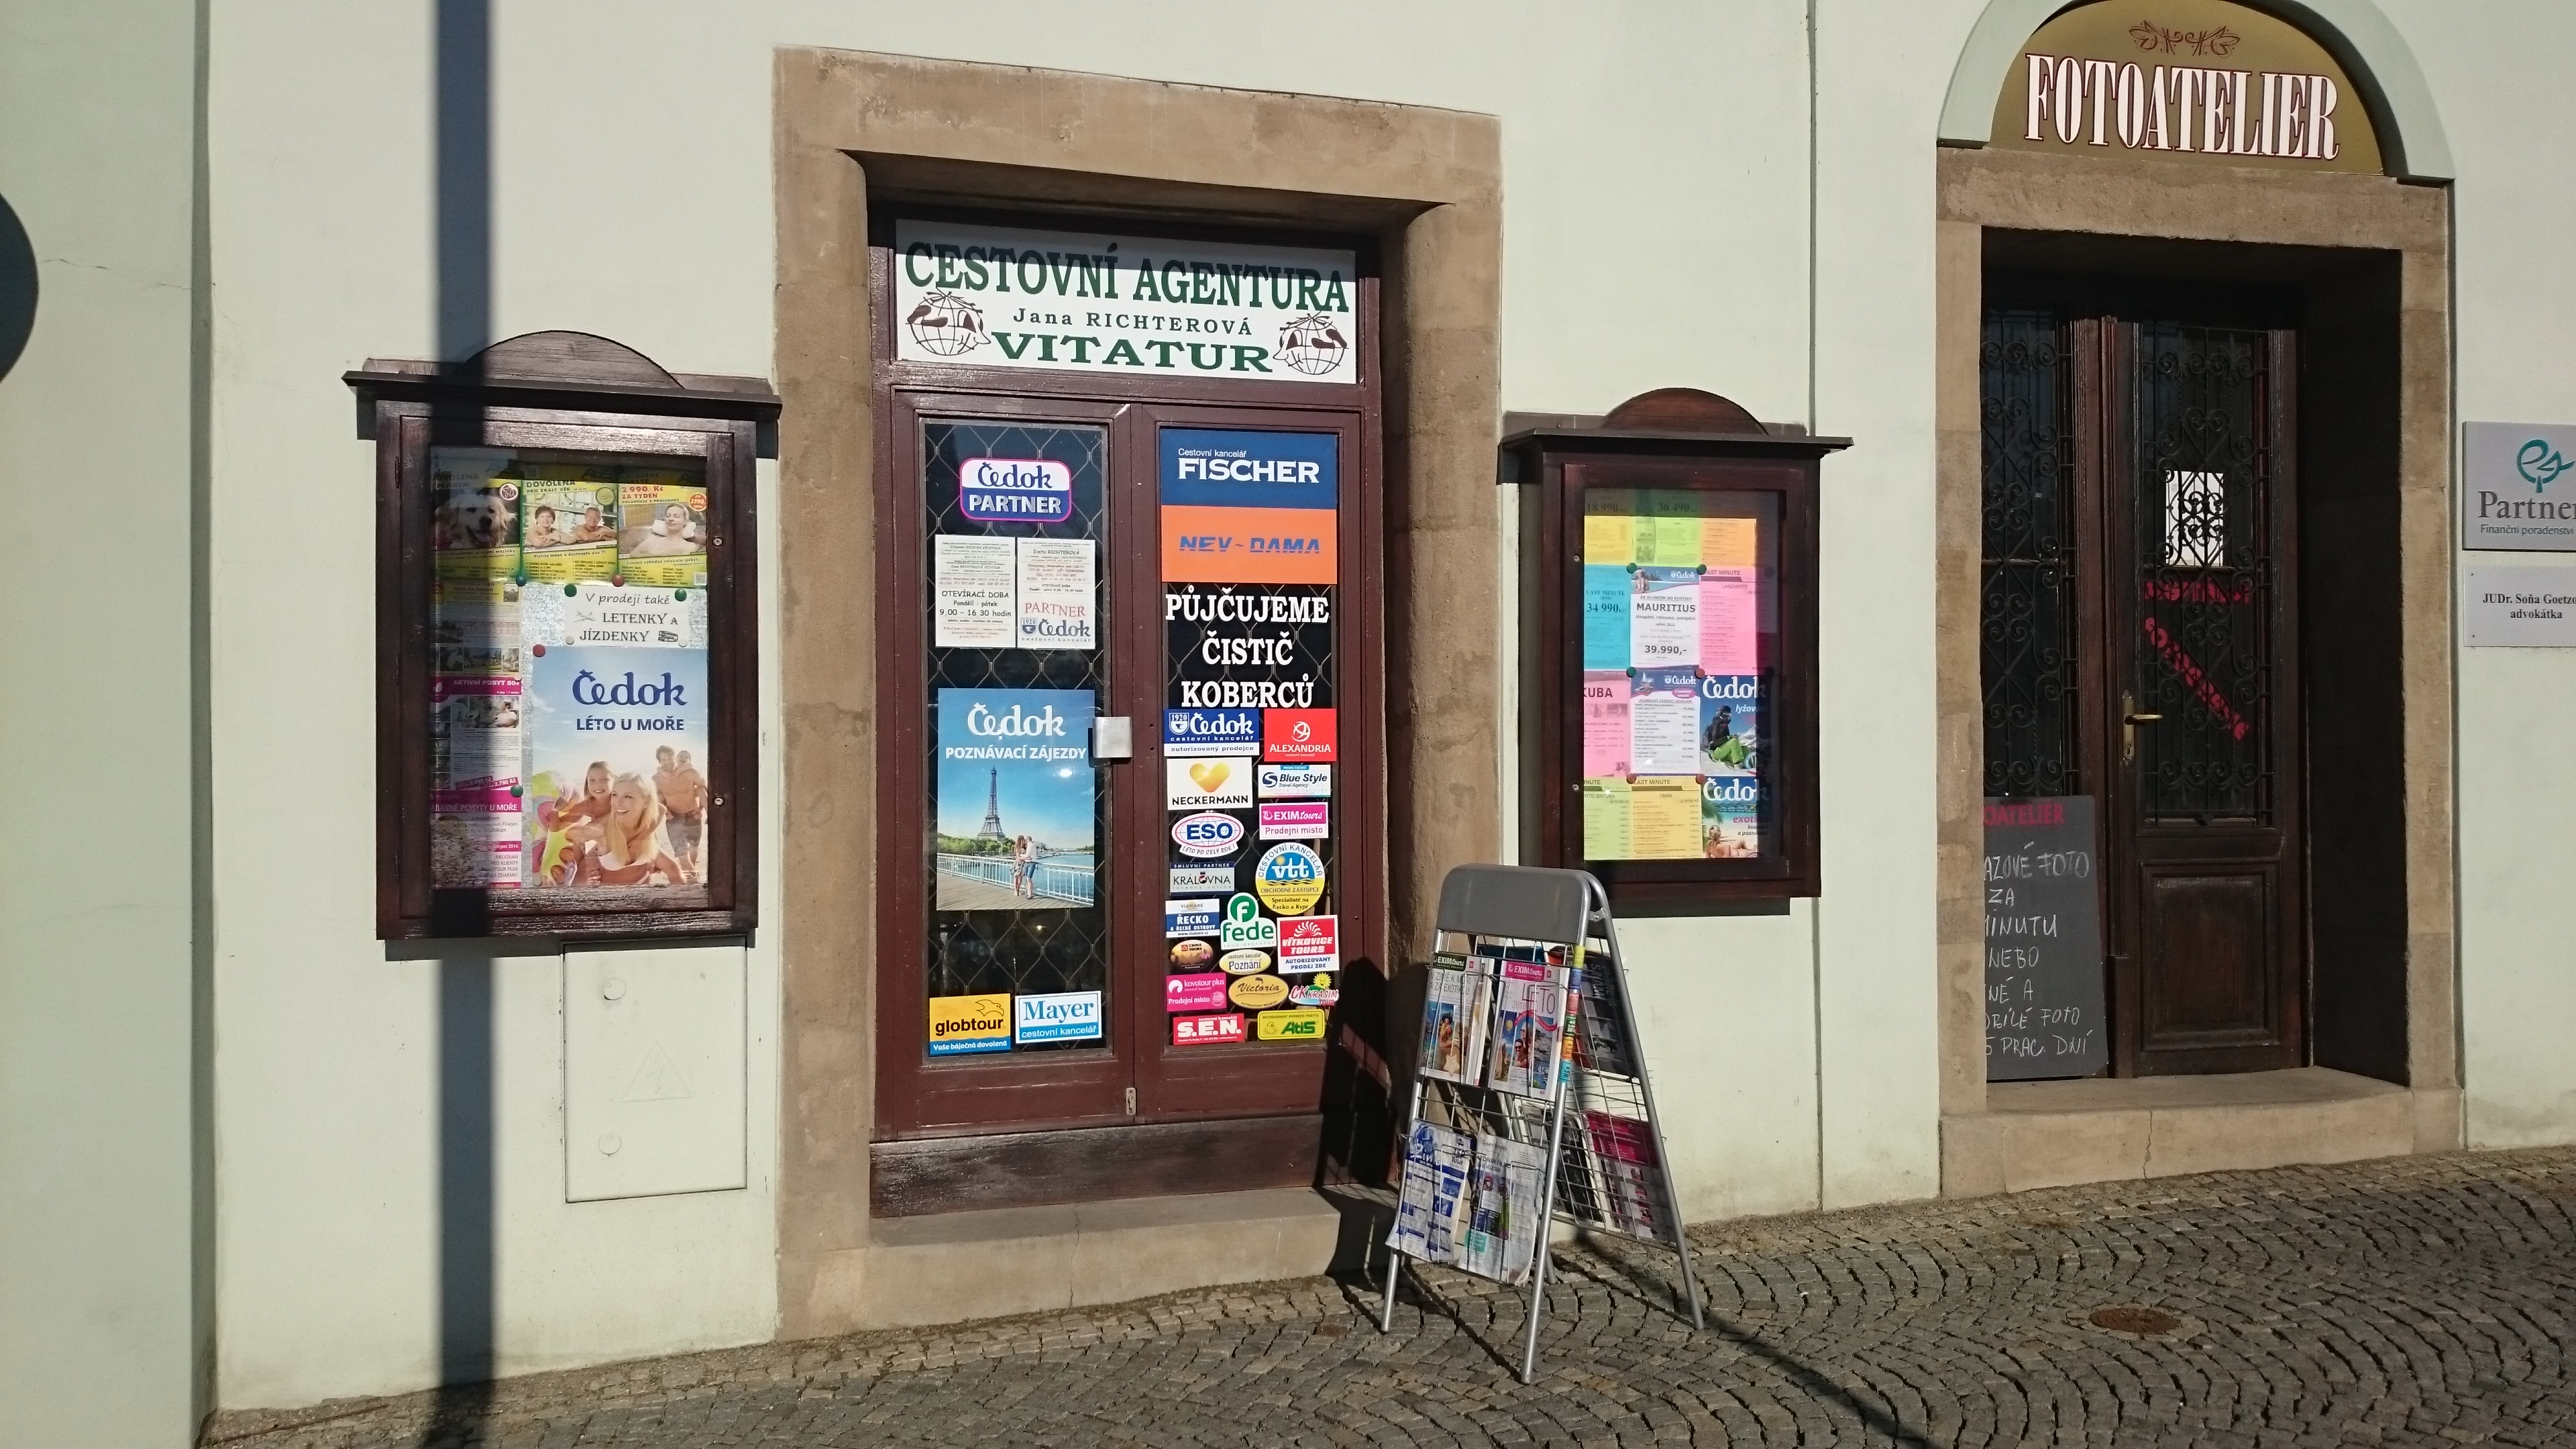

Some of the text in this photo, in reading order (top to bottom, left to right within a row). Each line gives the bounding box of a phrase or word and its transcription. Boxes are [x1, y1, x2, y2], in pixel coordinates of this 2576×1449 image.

[2024, 52, 2339, 161] FOTOATELIER
[905, 241, 1350, 313] CESTOVNÍ AGENTURA
[1013, 308, 1252, 336] Jana RICHTEROVÁ
[991, 331, 1273, 373] VITATUR
[1178, 447, 1247, 459] Cestovní kancelář
[977, 461, 1054, 489] Čedok
[1178, 457, 1320, 484] FISCHER
[969, 494, 1063, 515] PARTNER
[2481, 524, 2574, 536] Finanční poradenství
[586, 593, 670, 606] V prodeji také
[941, 589, 986, 598] OTEVÍRACÍ
[2483, 593, 2512, 604] JUDr.
[2516, 593, 2540, 604] Soňa
[1024, 602, 1086, 617] PARTNER
[1165, 584, 1329, 623] PŮJČUJEME
[1586, 602, 1619, 612] 34 990
[1636, 603, 1696, 612] MAURITIUS
[602, 612, 668, 625] LETENKY
[2510, 609, 2563, 619] advokátka
[579, 628, 650, 642] JÍZDENKY
[1038, 618, 1091, 637] Čedok
[1202, 630, 1294, 665] ČISTIČ
[572, 669, 688, 706] Čedok
[1672, 674, 1697, 685] Čedok
[1702, 675, 1767, 699] Čedok
[1181, 672, 1314, 708] KOBERCŮ
[576, 714, 685, 731] LÉTO U MOŘE
[967, 702, 1067, 737] Čedok
[1171, 712, 1254, 735] 1920 Čedok
[945, 744, 1087, 762] POZNÁVACÍ ZÁJEZDY
[1269, 743, 1332, 753] ALEXANDRIA
[1279, 773, 1328, 784] Blue Style
[1703, 777, 1769, 801] Čedok
[496, 802, 518, 811] MOŘE
[1172, 795, 1248, 806] NECKERMANN
[1186, 822, 1233, 841] ESO
[1265, 826, 1323, 836] Prodejní místo
[1258, 843, 1324, 877] CESTOVNÍ KANCELÁŘ
[1271, 857, 1309, 879] vtt
[2037, 851, 2089, 878] FOTO
[1173, 873, 1231, 885] KRÁLOVNA
[1988, 888, 2015, 906] ZA
[1177, 914, 1209, 925] ŘECKO
[1223, 921, 1274, 943] fede
[1282, 936, 1334, 947] VÍTKOVICE
[1291, 945, 1325, 955] TOURS
[1229, 959, 1262, 971] Poznání
[1988, 946, 2039, 969] NEBO
[1212, 979, 1225, 988] plus
[1238, 983, 1280, 993] Victoria
[1291, 985, 1339, 999] CK KRASIM
[2023, 979, 2033, 1001] A
[1168, 997, 1193, 1005] Prodejní
[1022, 1000, 1095, 1024] Mayer
[2041, 1006, 2080, 1026] FOTO
[935, 1018, 1004, 1037] globtour
[1022, 1025, 1097, 1038] cestovní kancelář
[1177, 1019, 1242, 1038] S.E.N.
[1281, 1020, 1316, 1035] AtiS
[950, 1041, 977, 1051] báječná
[977, 1040, 1008, 1049] dovolená
[2000, 1029, 2093, 1058] PRAC. DNÍ
